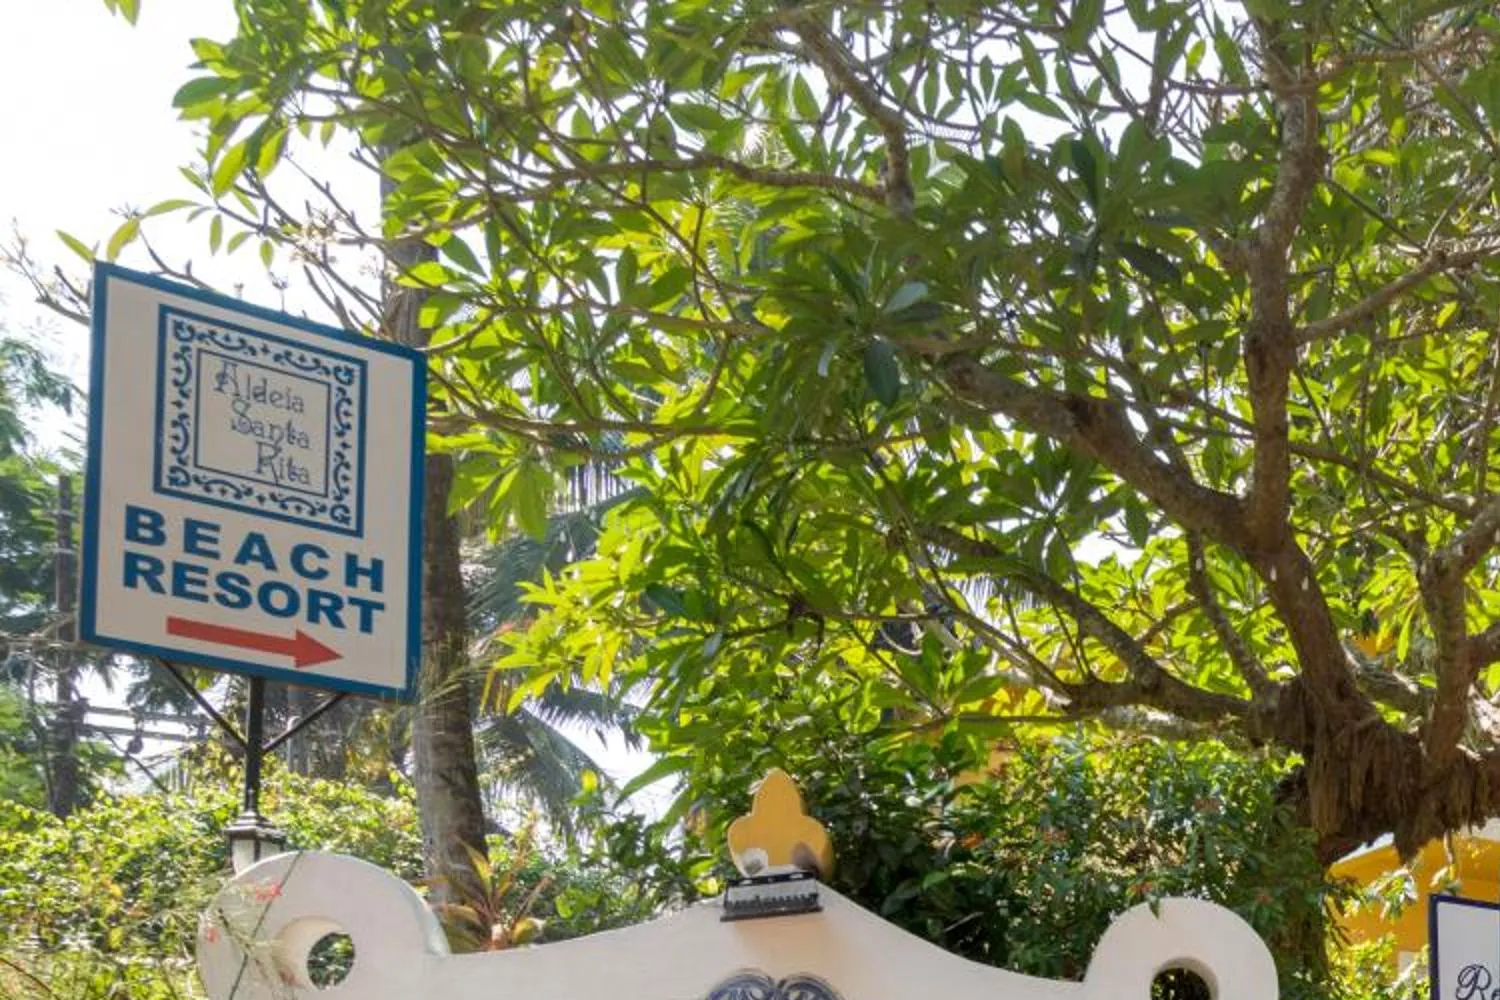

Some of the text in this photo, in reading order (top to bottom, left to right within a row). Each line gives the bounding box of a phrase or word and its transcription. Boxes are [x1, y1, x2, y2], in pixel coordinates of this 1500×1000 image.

[214, 361, 305, 413] Aldeia
[231, 398, 310, 450] Santa
[256, 440, 311, 486] Rita
[124, 504, 385, 593] BEACH
[122, 550, 386, 634] RESORT
